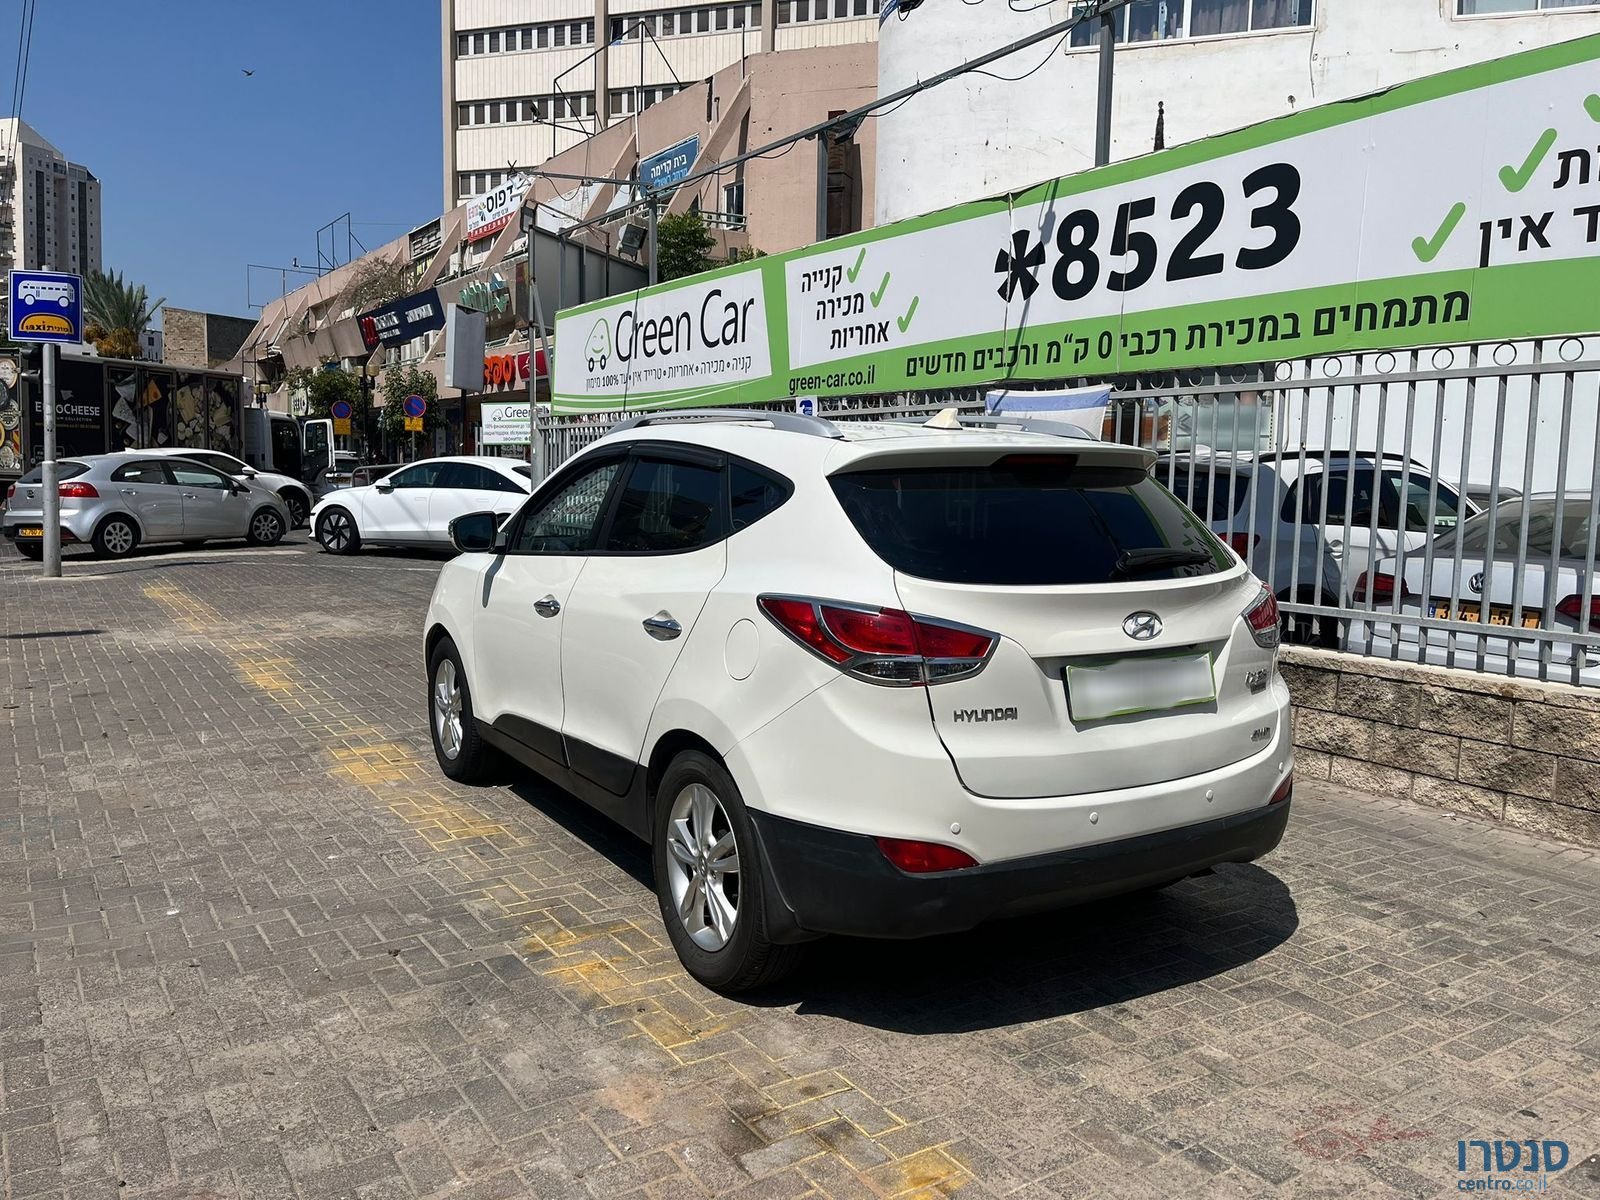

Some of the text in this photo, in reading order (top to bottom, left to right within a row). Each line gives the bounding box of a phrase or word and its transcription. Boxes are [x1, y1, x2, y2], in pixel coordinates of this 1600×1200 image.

[651, 154, 687, 179] בית קדימה
[486, 185, 514, 213] דפוס
[1479, 211, 1555, 268] אין
[801, 265, 843, 293] קנייה
[816, 293, 865, 321] מכירה
[1313, 290, 1470, 336] מתמחים
[25, 321, 46, 331] taxi
[615, 288, 755, 362] Green Car
[830, 320, 890, 350] אחריות
[1185, 310, 1301, 351] במכירת
[1098, 330, 1113, 360] 0
[1121, 326, 1177, 356] רכבי
[700, 359, 725, 375] מכירה
[731, 355, 752, 373] קניה
[906, 349, 967, 377] חדשים
[973, 342, 1038, 371] ורכבים
[602, 374, 619, 387] 100%
[667, 363, 695, 379] אחריות
[788, 364, 875, 395] green-car.co.il
[953, 707, 1018, 722] HYUNDAI
